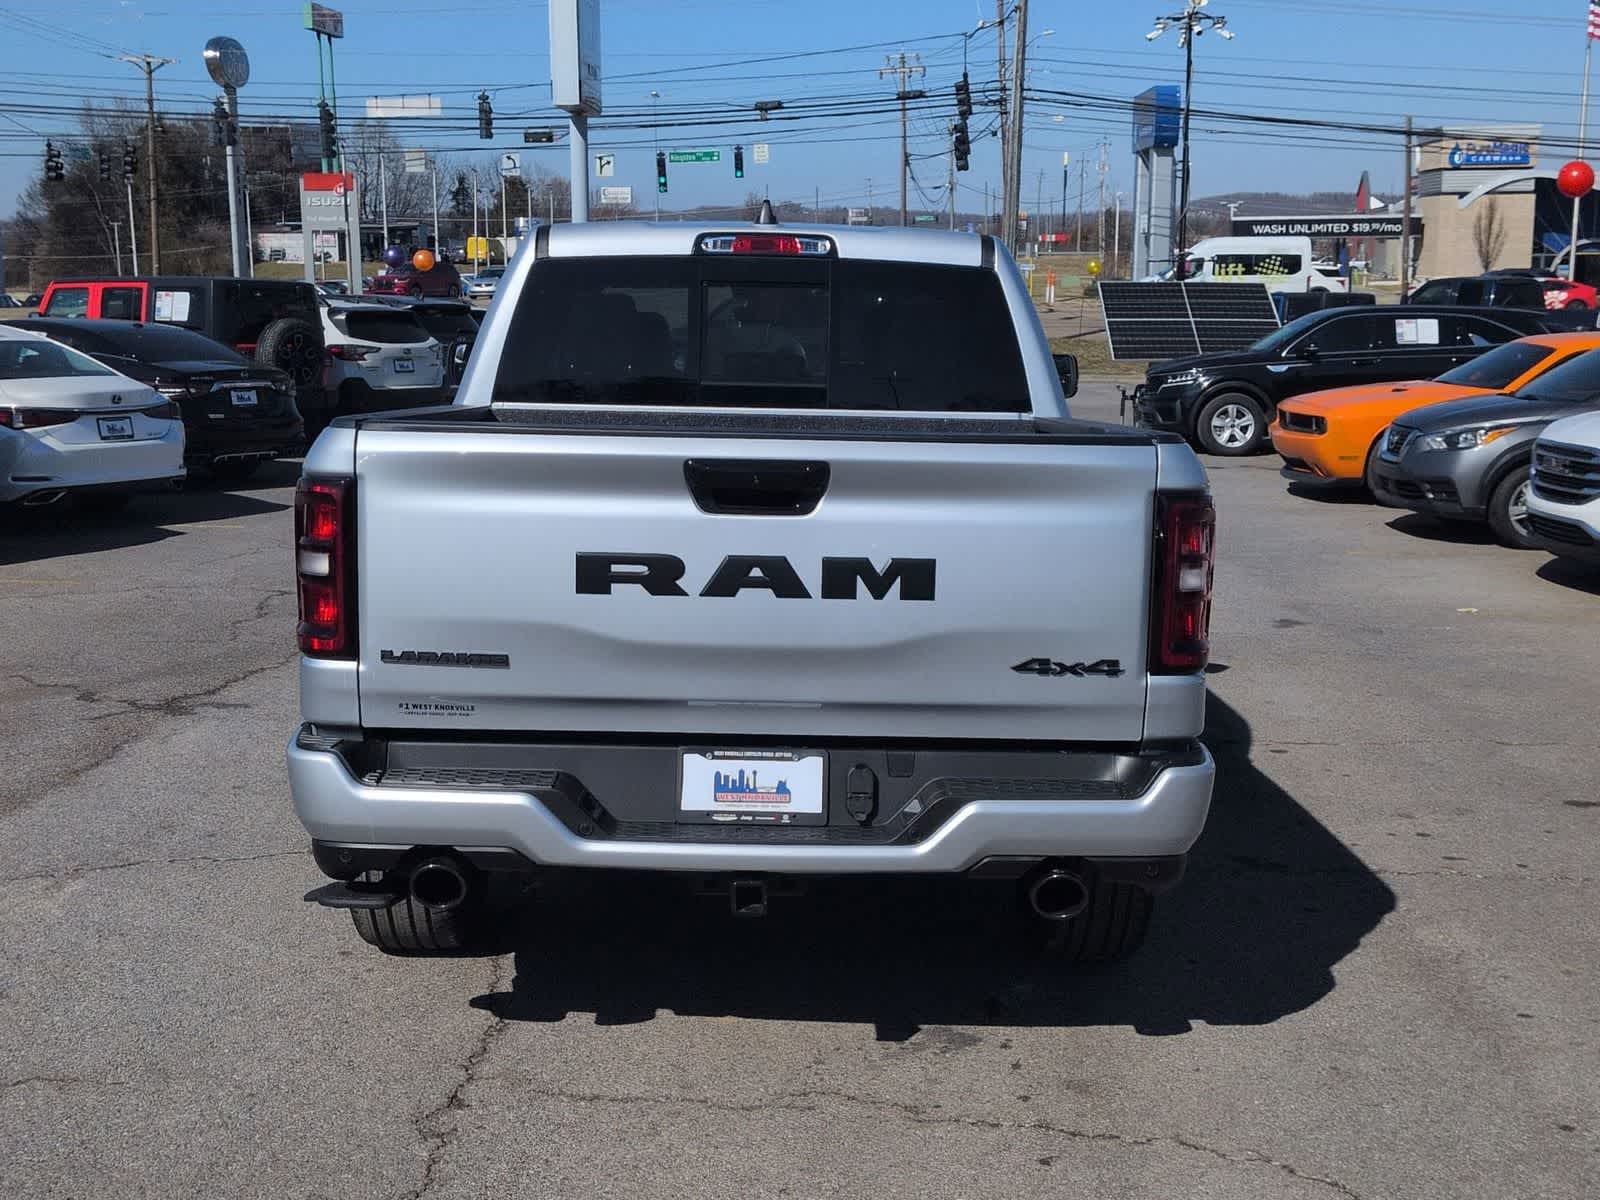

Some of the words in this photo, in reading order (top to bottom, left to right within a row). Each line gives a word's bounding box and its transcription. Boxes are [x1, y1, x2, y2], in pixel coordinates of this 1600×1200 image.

[1252, 224, 1287, 234] WASH
[1288, 223, 1349, 233] UNLIMITED
[575, 551, 937, 601] RAM
[380, 650, 510, 669] LARAMIE
[1009, 657, 1126, 678] 4x4
[411, 703, 433, 711] WEST
[434, 703, 475, 712] KNOXVILLE
